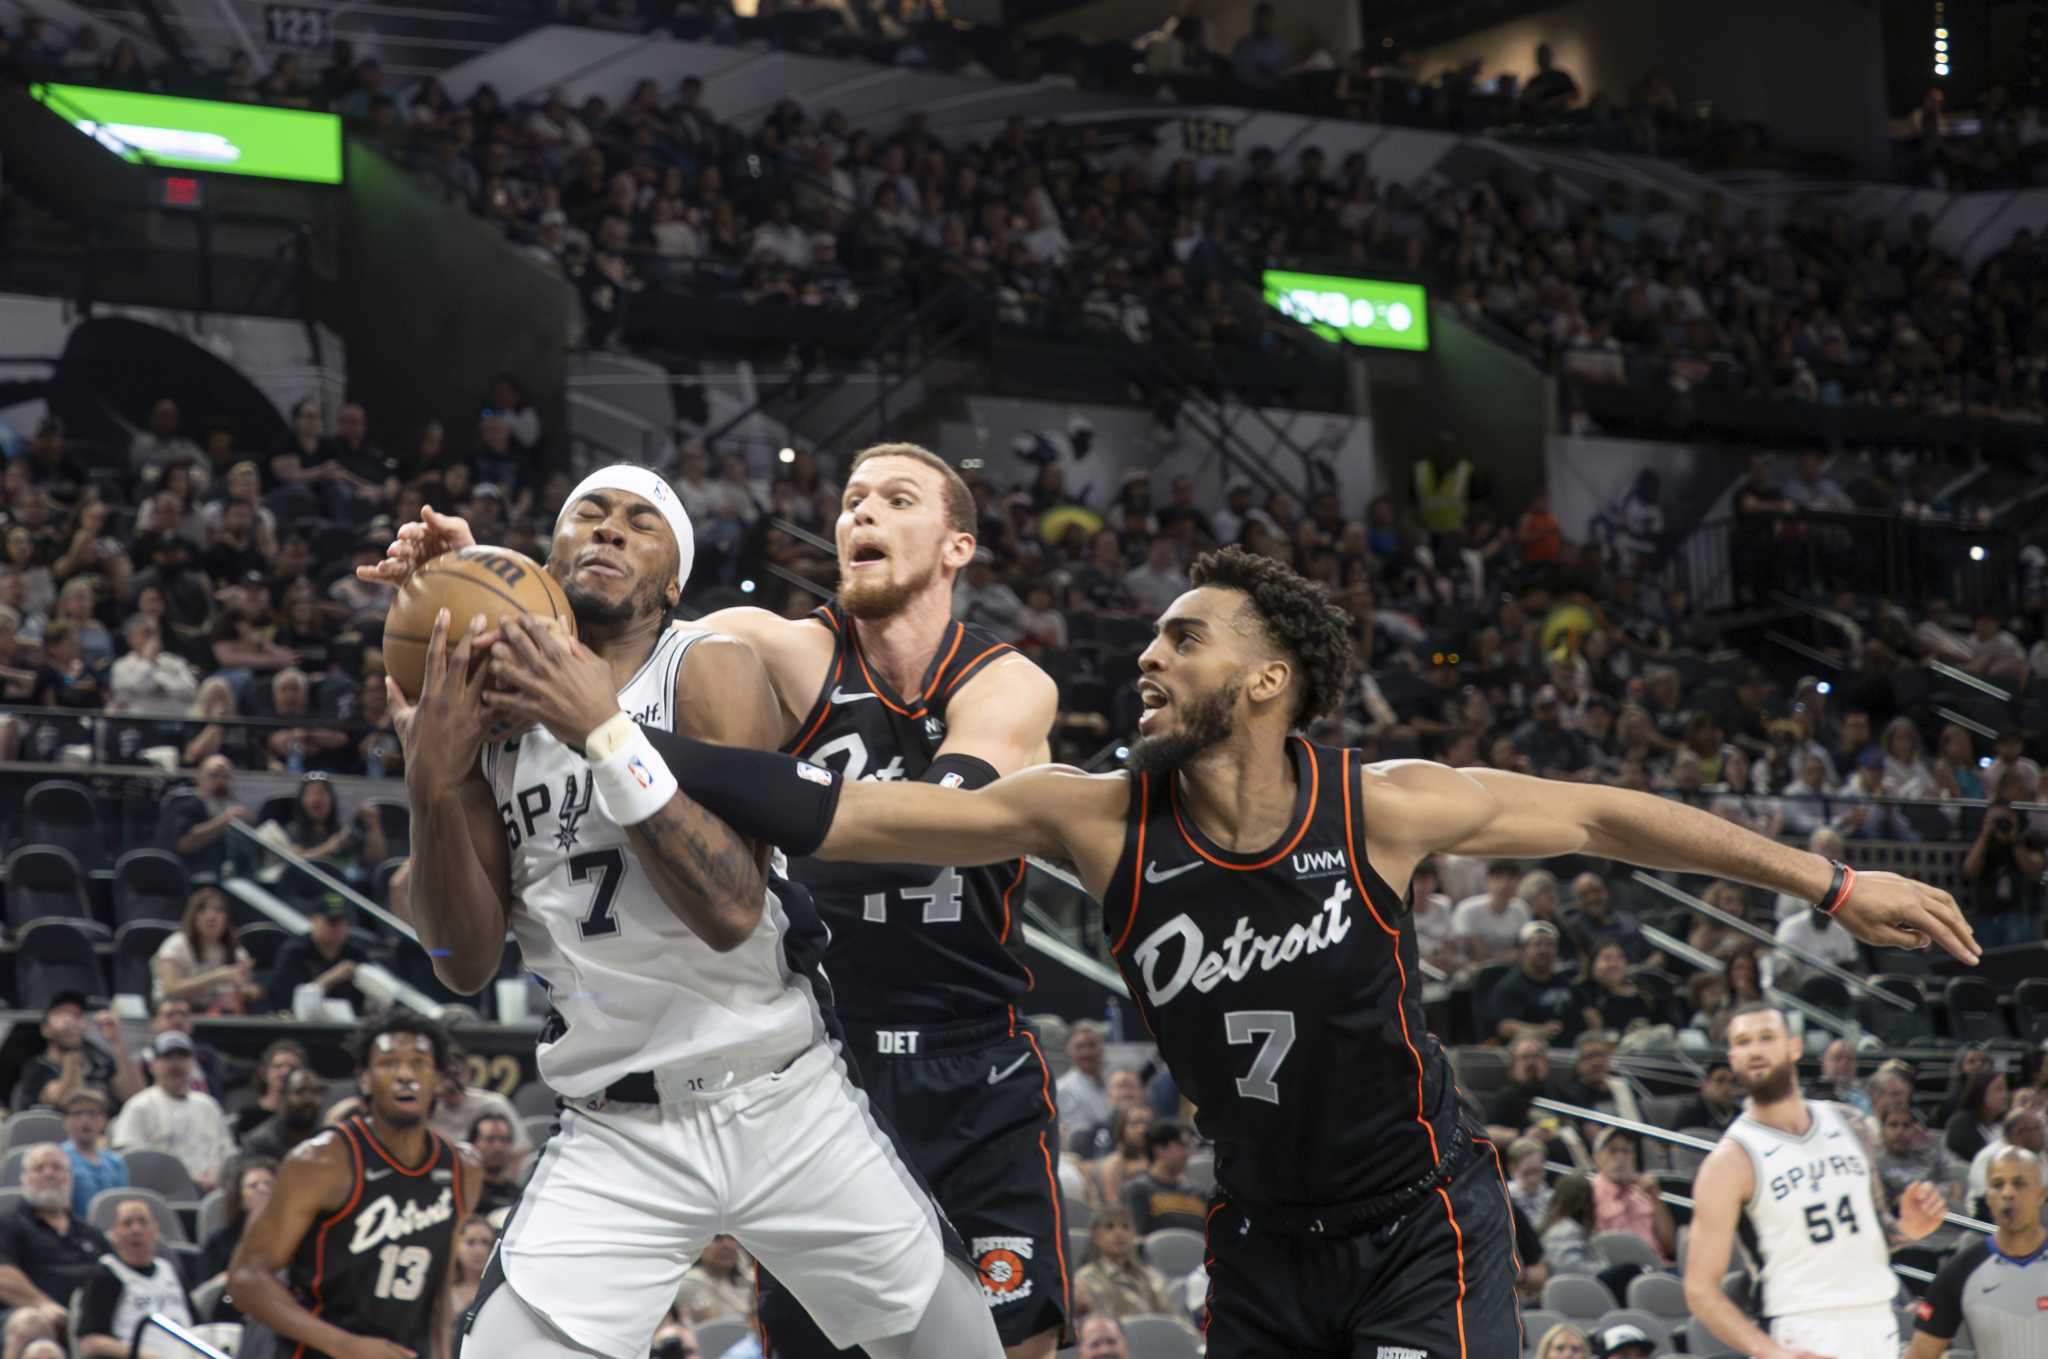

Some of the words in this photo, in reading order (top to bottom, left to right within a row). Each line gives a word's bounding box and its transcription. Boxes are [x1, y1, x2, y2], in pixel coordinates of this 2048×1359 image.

[625, 702, 662, 726] elf.
[500, 768, 595, 852] SPU
[1292, 849, 1346, 874] UWM
[567, 844, 627, 942] 7
[1133, 878, 1352, 1008] Detroit
[875, 1030, 921, 1055] DET
[1224, 1010, 1296, 1105] 7
[1770, 1153, 1866, 1201] SPURS
[349, 1186, 452, 1255] Detroit
[1804, 1194, 1860, 1245] 54
[374, 1243, 432, 1301] 13
